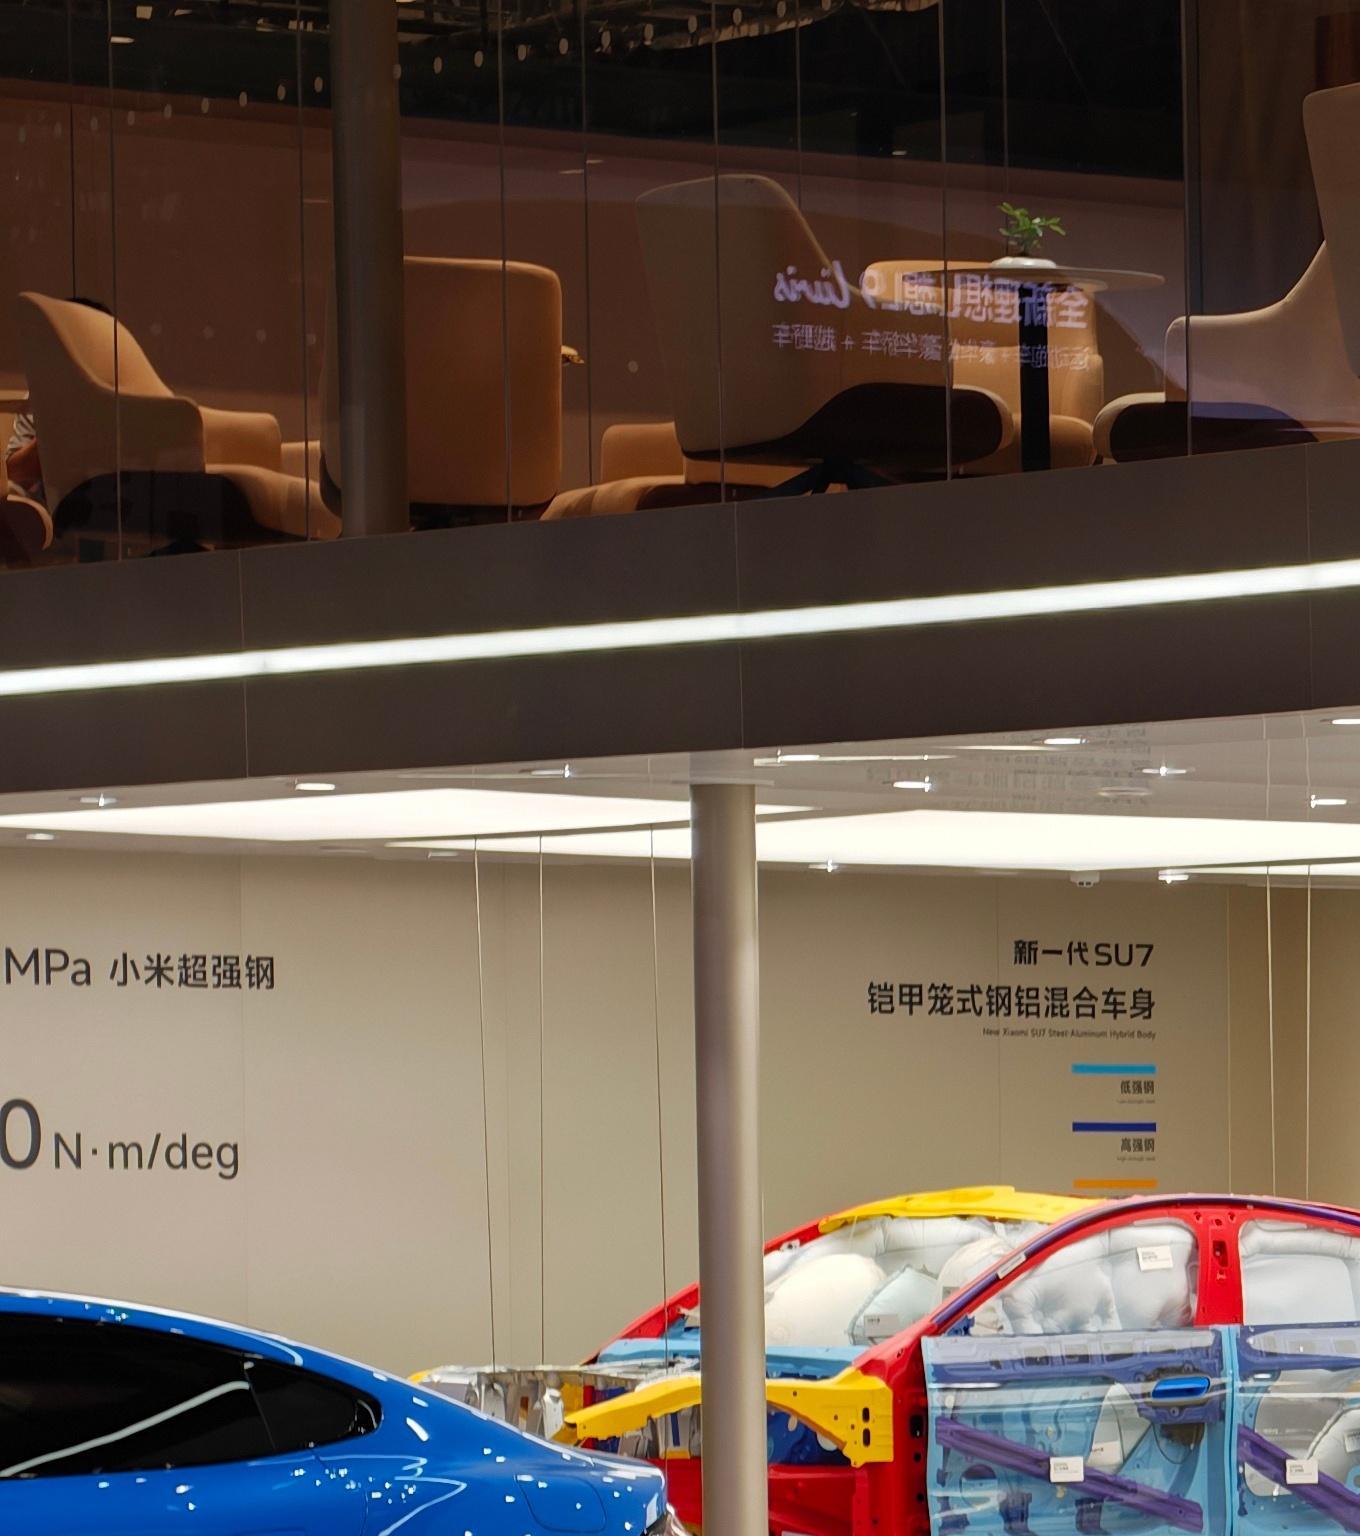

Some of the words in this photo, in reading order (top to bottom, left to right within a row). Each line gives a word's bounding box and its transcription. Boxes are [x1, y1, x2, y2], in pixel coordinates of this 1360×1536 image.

[5, 947, 91, 986] MPa
[109, 952, 275, 990] 小米超强钢
[867, 981, 1157, 1020] 铠甲笼式钢铝混合车身
[1120, 1137, 1155, 1153] 高强钢
